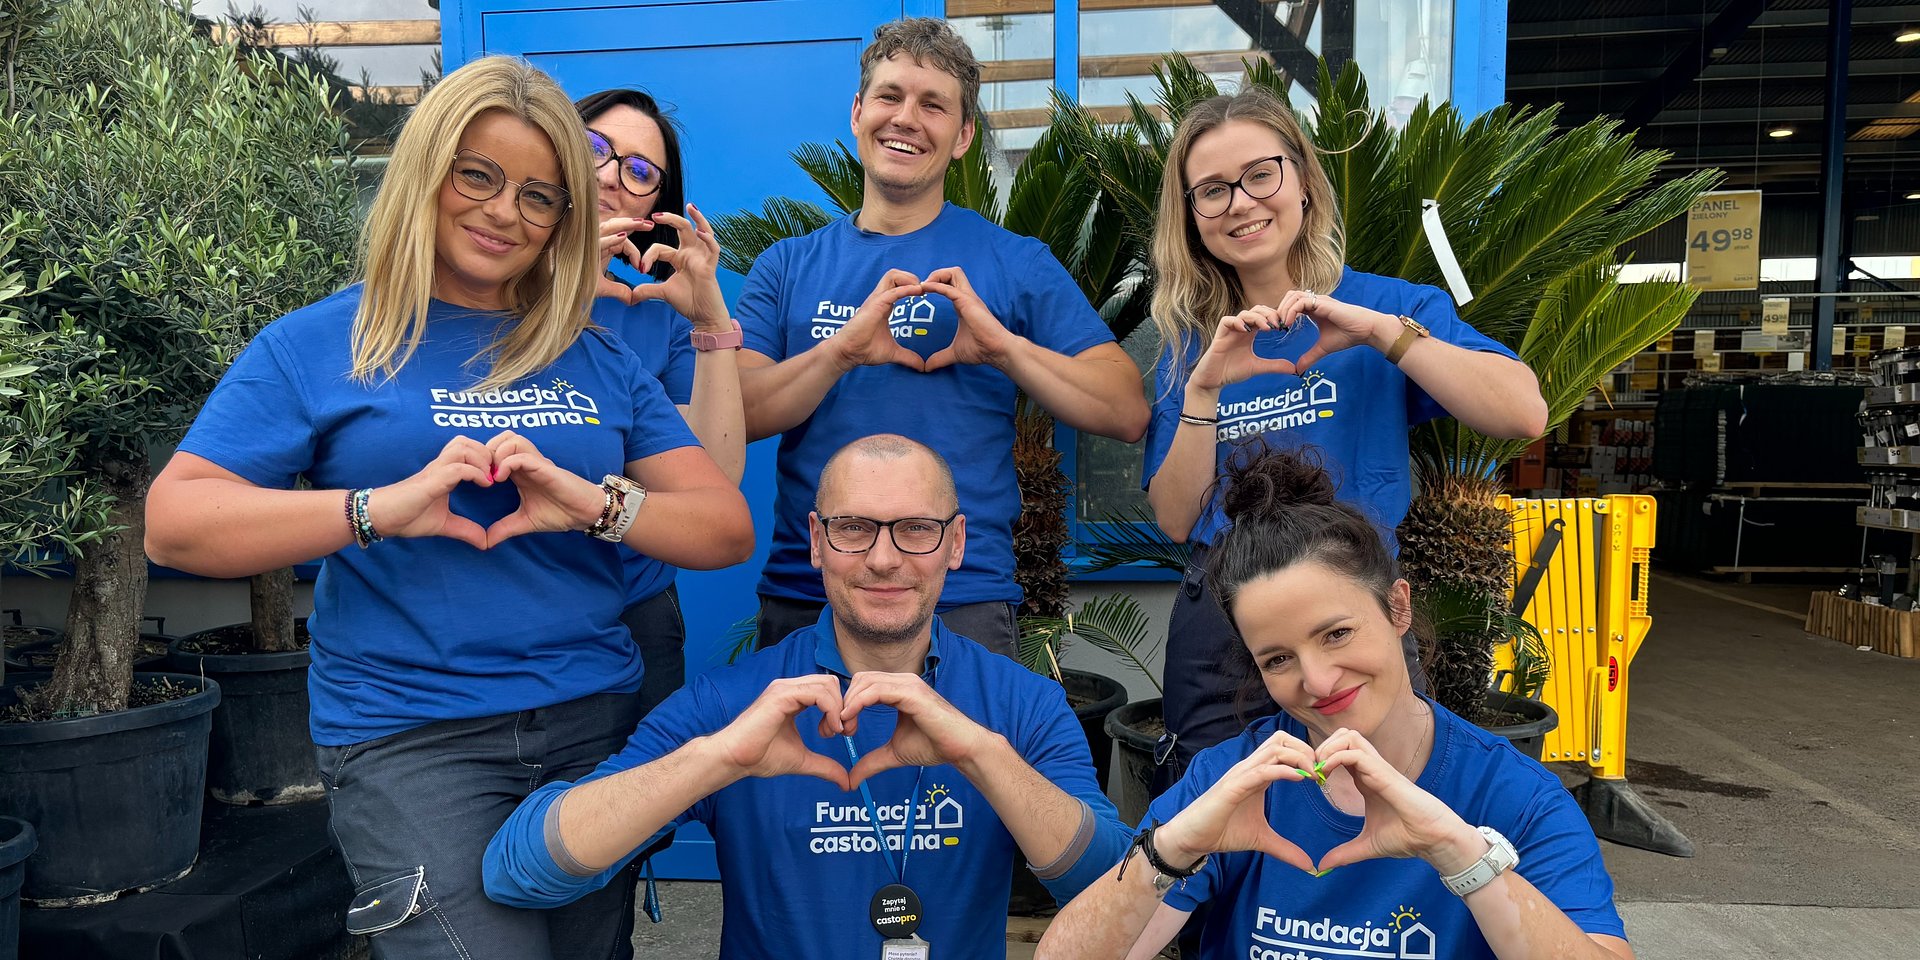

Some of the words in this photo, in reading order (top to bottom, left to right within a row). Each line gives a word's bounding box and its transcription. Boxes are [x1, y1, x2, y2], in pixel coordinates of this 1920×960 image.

[1692, 200, 1740, 212] PANEL
[1692, 212, 1728, 220] ZIELONY
[818, 300, 905, 319] Funa
[430, 383, 559, 405] Fundacja
[433, 411, 584, 428] castorama
[1217, 409, 1317, 443] astorama
[816, 798, 927, 825] Fundacja
[809, 832, 940, 854] castoama
[882, 897, 906, 905] Zapytaj
[877, 914, 917, 925] castopro
[1256, 906, 1390, 951] Fundacja
